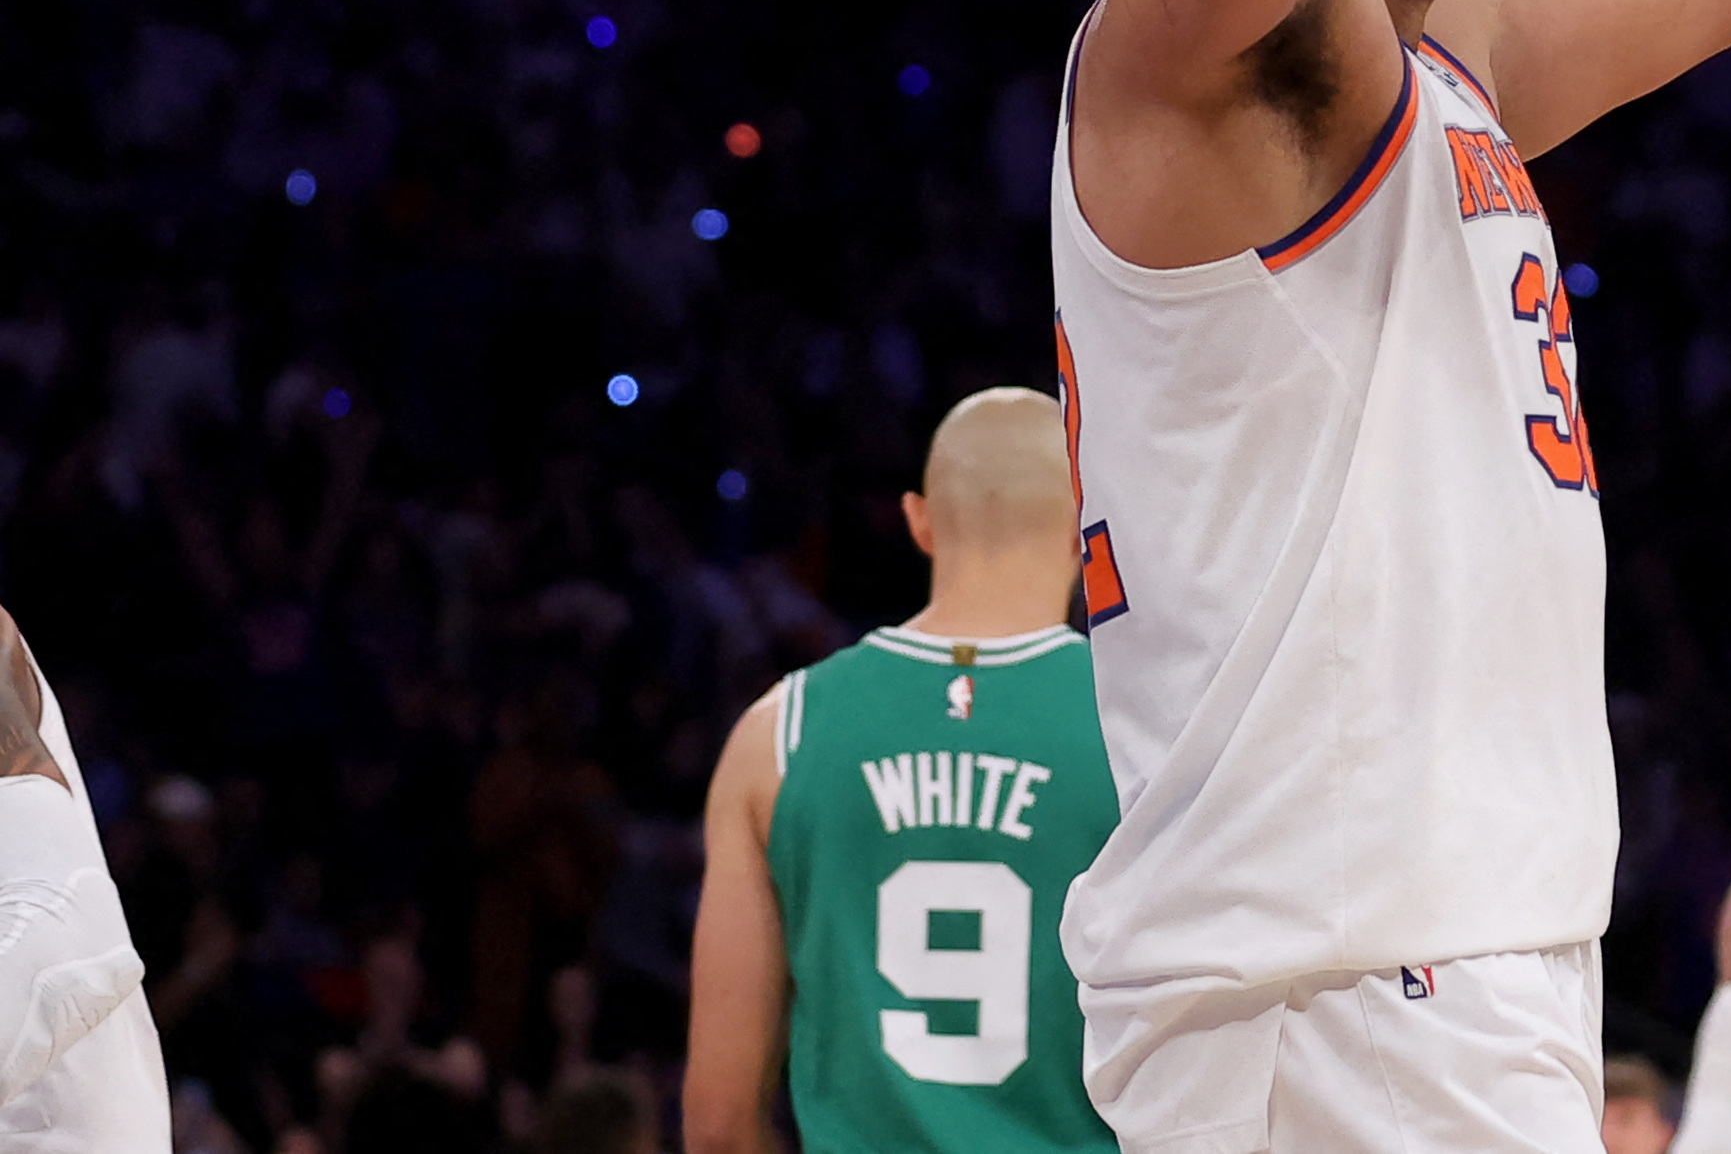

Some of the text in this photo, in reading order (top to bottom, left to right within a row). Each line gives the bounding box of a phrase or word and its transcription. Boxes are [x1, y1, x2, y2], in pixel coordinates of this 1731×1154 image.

[1443, 123, 1541, 224] NEW
[860, 750, 1053, 841] WHITE
[876, 860, 1033, 1086] 9
